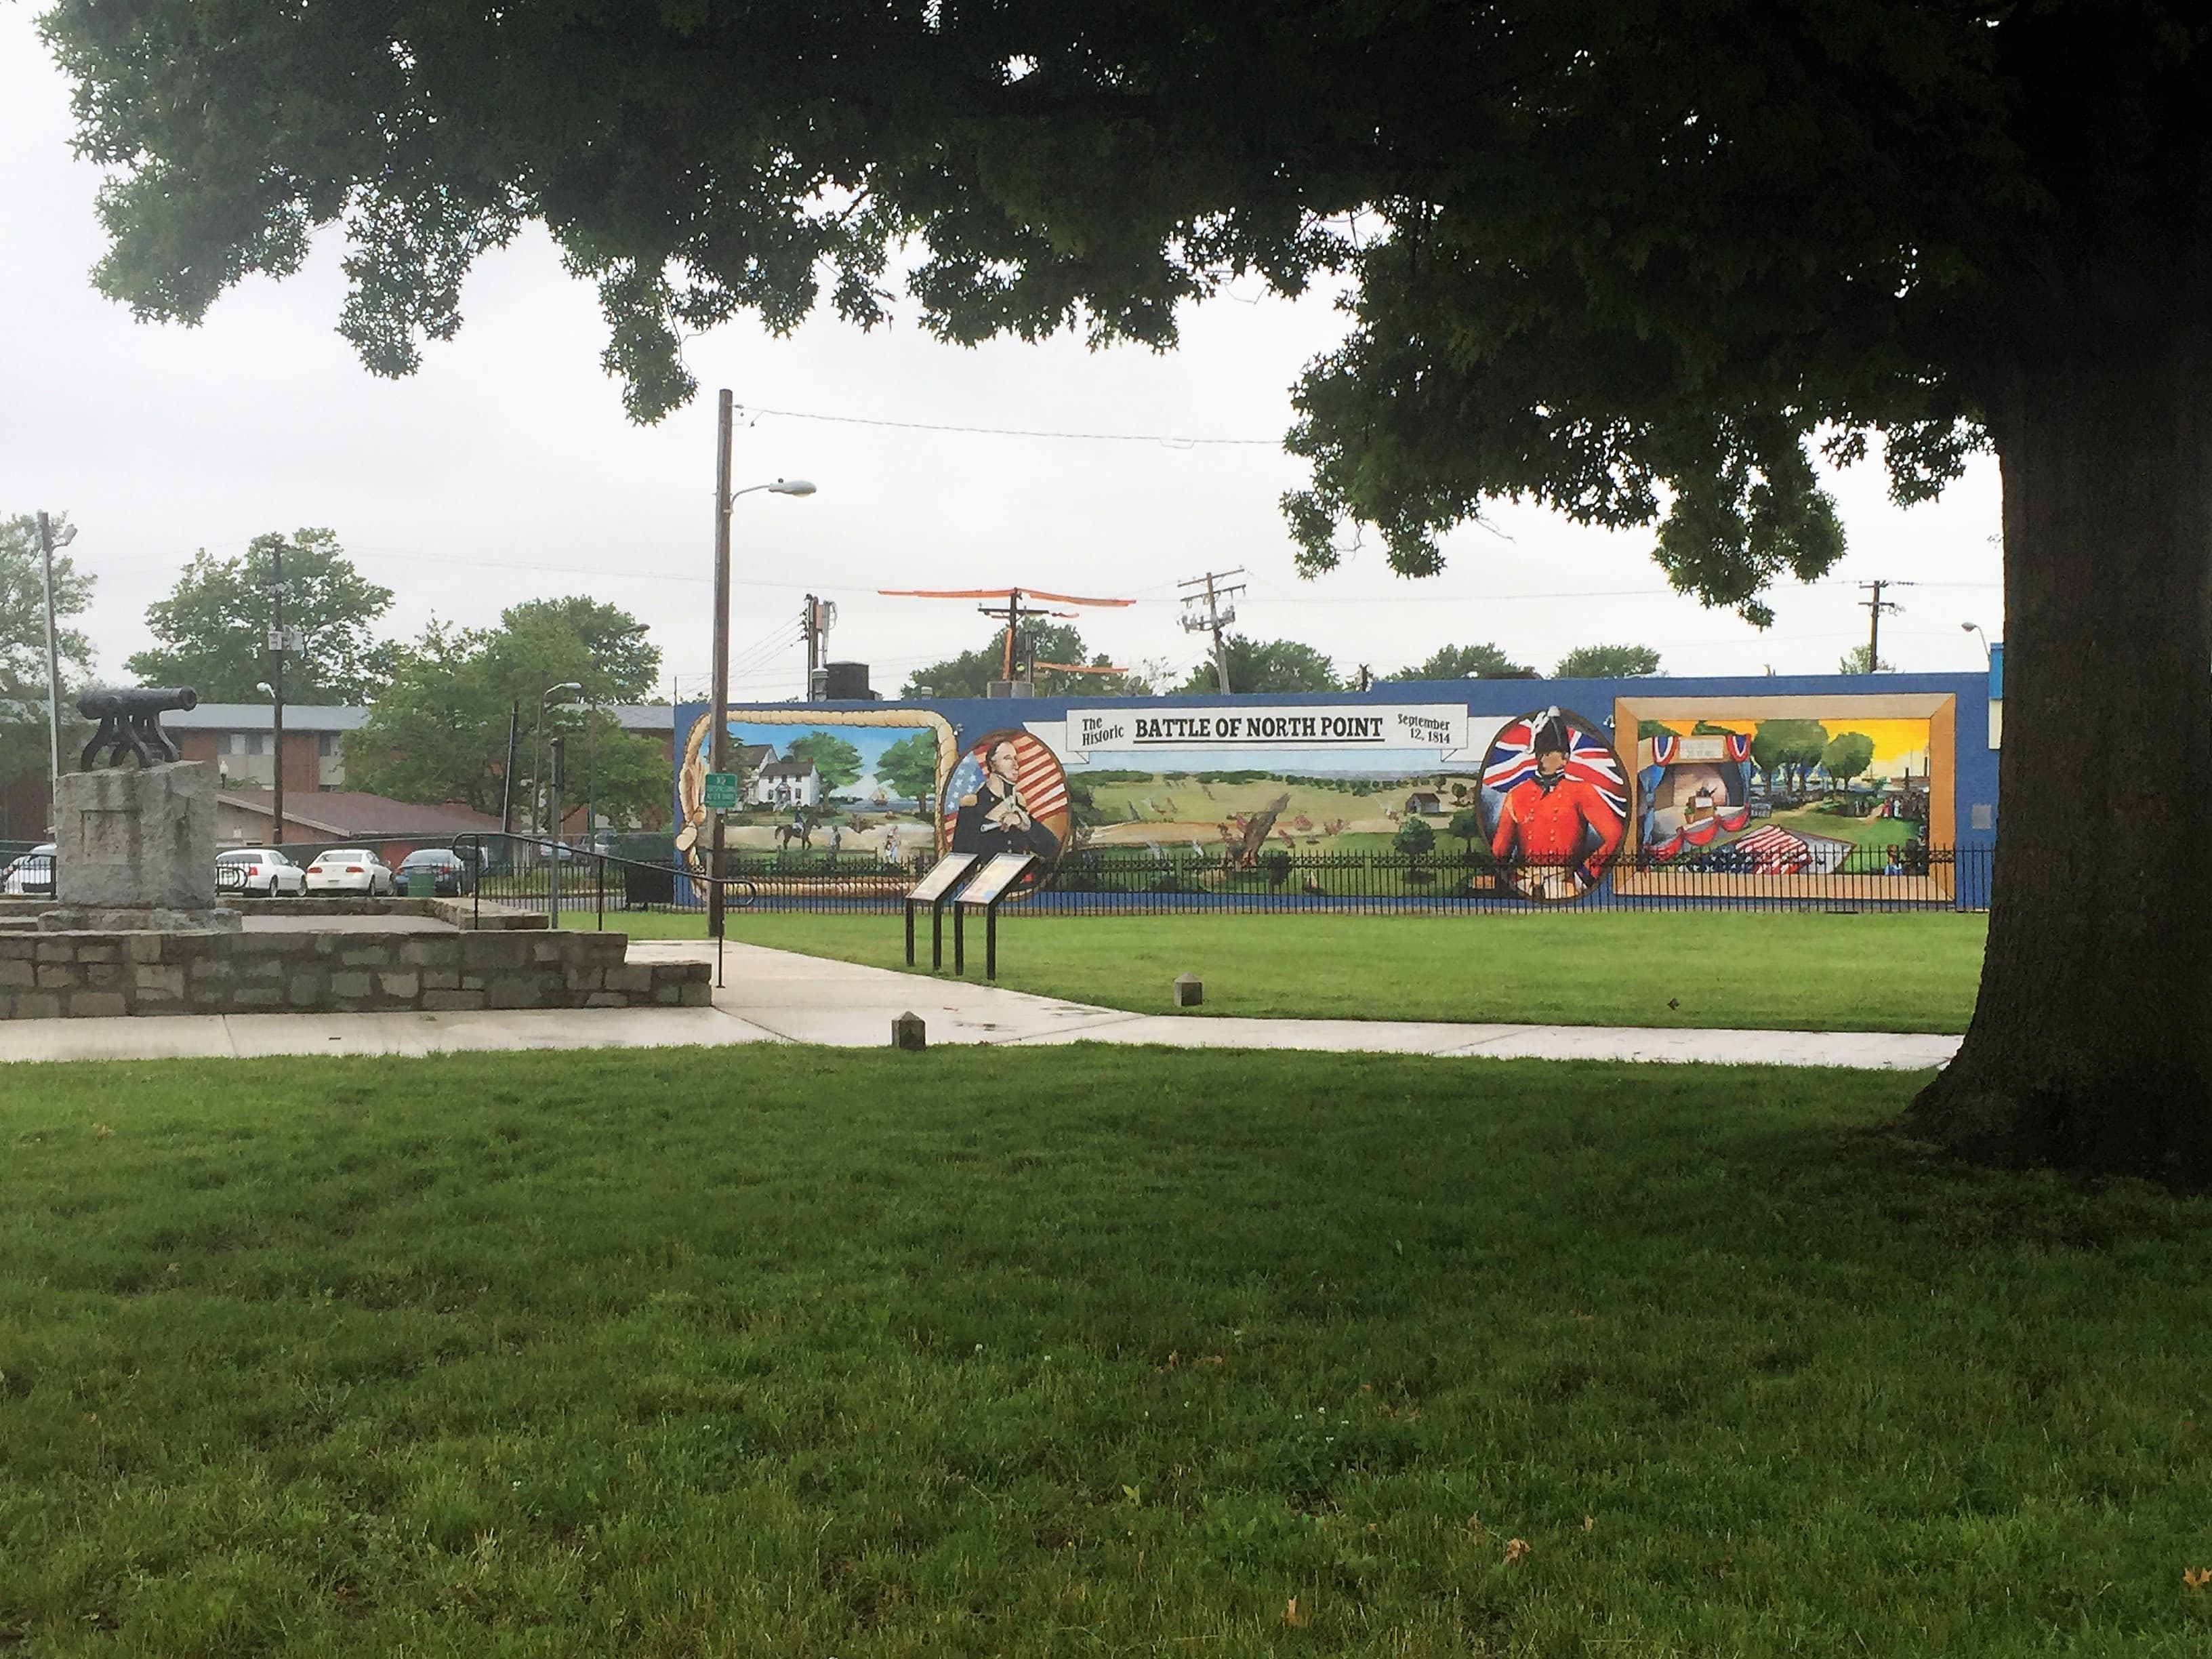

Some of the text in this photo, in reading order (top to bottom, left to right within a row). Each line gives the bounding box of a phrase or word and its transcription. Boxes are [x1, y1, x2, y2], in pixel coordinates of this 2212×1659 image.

[1082, 717, 1103, 731] The
[1135, 716, 1383, 737] BATTLE OF NORTH POINT
[1397, 713, 1450, 731] September
[1082, 724, 1124, 746] Historic
[1410, 727, 1450, 744] 12, 1814
